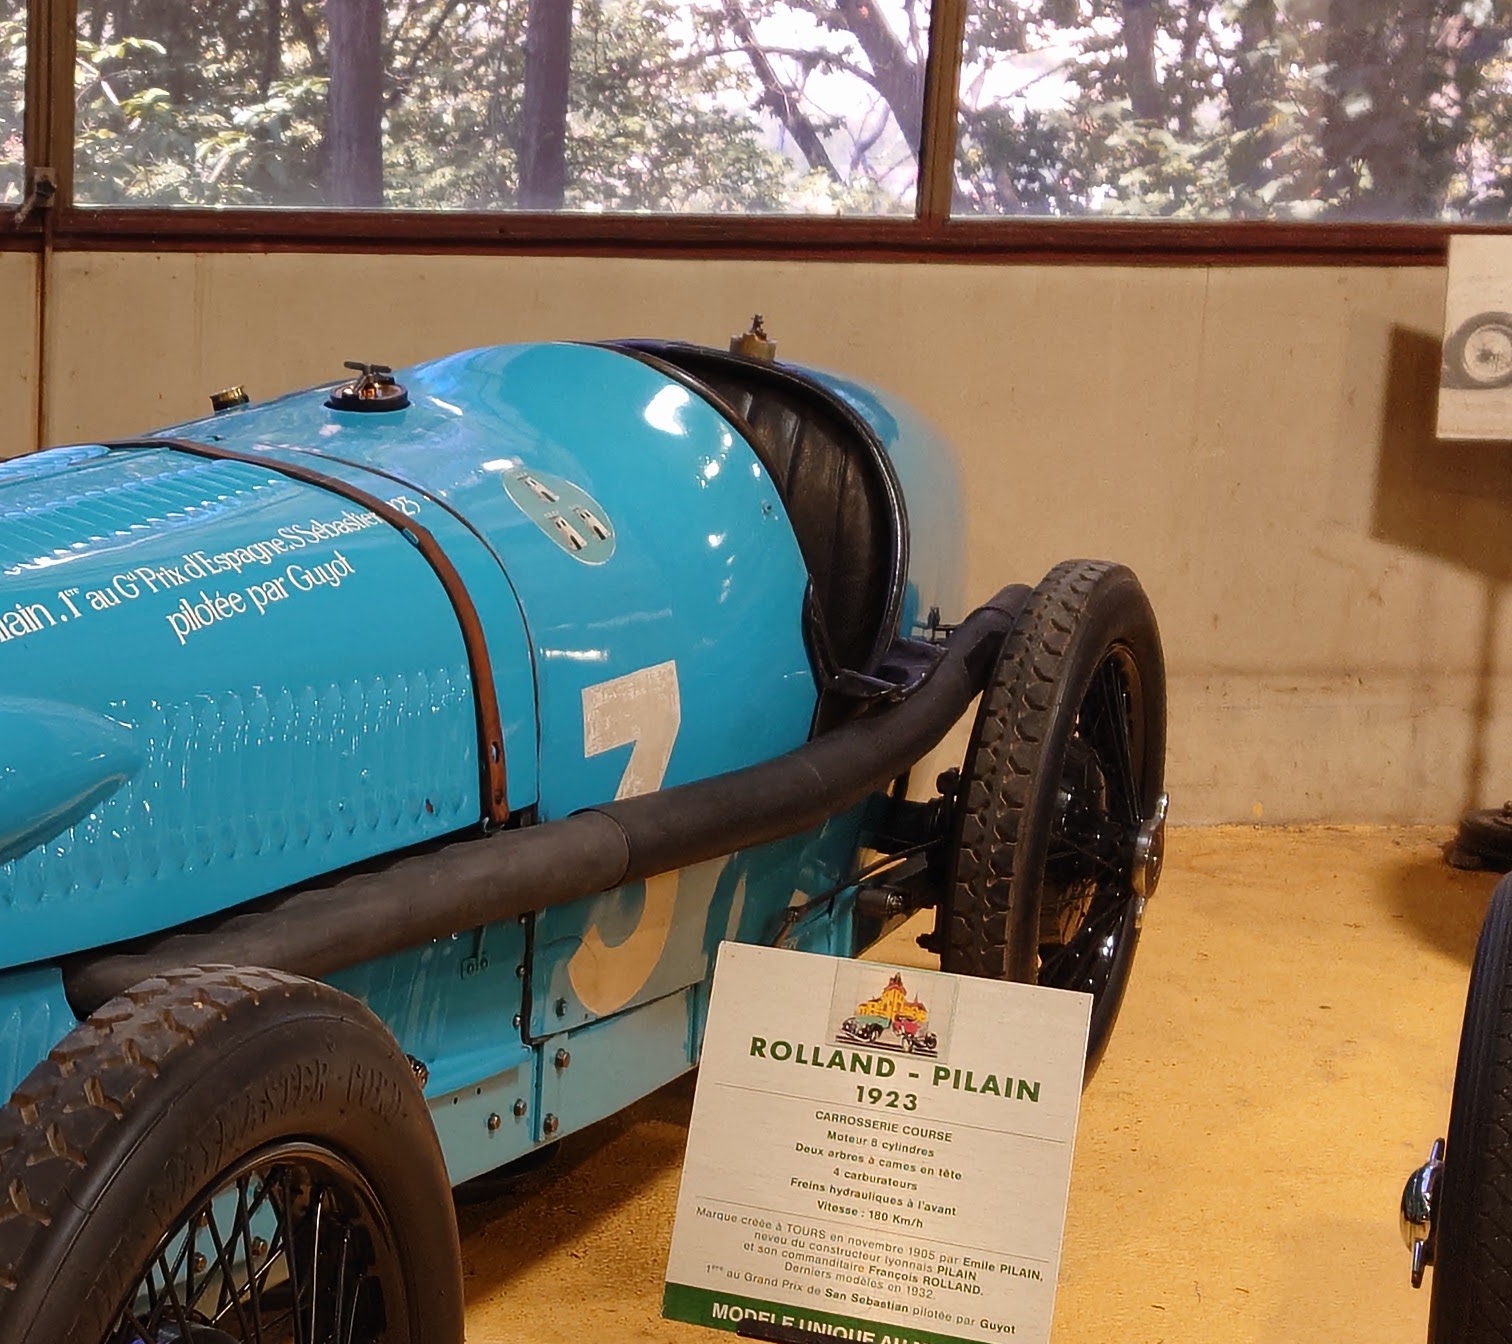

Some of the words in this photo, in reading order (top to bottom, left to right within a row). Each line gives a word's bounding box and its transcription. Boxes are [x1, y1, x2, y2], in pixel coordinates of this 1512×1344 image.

[85, 587, 121, 611] au
[134, 567, 190, 593] Prix
[166, 590, 246, 645] pilotée
[245, 577, 289, 616] par
[286, 550, 356, 591] Guyot
[749, 1036, 896, 1078] ROLLAND
[933, 1066, 1041, 1103] PILAIN
[856, 1085, 918, 1111] 1923
[815, 1110, 899, 1133] CARROSSERIE
[902, 1125, 953, 1143] COURSE
[826, 1130, 868, 1146] Moteur
[882, 1140, 935, 1158] cylindres
[795, 1142, 824, 1156] Deux
[827, 1148, 864, 1163] arbres
[878, 1159, 916, 1172] cames
[920, 1166, 934, 1176] en
[790, 1177, 825, 1192] Freins
[829, 1184, 903, 1207] hydrauliques
[917, 1199, 957, 1216] l'avant
[833, 1167, 840, 1177] 4
[844, 1169, 918, 1191] carburateurs
[817, 1200, 858, 1217] Vitesse
[868, 1210, 888, 1221] 180
[892, 1214, 924, 1229] Km/h
[696, 1206, 737, 1223] Marque
[787, 1223, 826, 1239] TOURS
[830, 1233, 844, 1243] en
[848, 1235, 904, 1254] novembre
[908, 1246, 935, 1260] 1905
[939, 1254, 959, 1265] par
[962, 1257, 996, 1272] Emile
[1000, 1264, 1044, 1282] PILAIN,
[754, 1232, 787, 1245] neveu
[791, 1238, 806, 1249] du
[809, 1241, 881, 1262] constructeur
[885, 1255, 933, 1273] lyonnais
[937, 1265, 977, 1281] PILAIN
[743, 1242, 754, 1251] et
[757, 1245, 778, 1256] son
[781, 1249, 865, 1273] commanditaire
[868, 1265, 918, 1284] François
[922, 1276, 984, 1295] ROLLAND.
[784, 1261, 832, 1279] Derniers
[835, 1273, 884, 1289] modèles
[888, 1283, 902, 1293] en
[726, 1269, 740, 1280] au
[744, 1272, 778, 1287] Grand
[781, 1281, 803, 1292] Prix
[806, 1285, 821, 1296] de
[825, 1288, 847, 1301] San
[850, 1292, 909, 1313] Sebastian
[912, 1306, 952, 1323] pilotée
[956, 1315, 976, 1327] par
[979, 1318, 1016, 1335] Guyot
